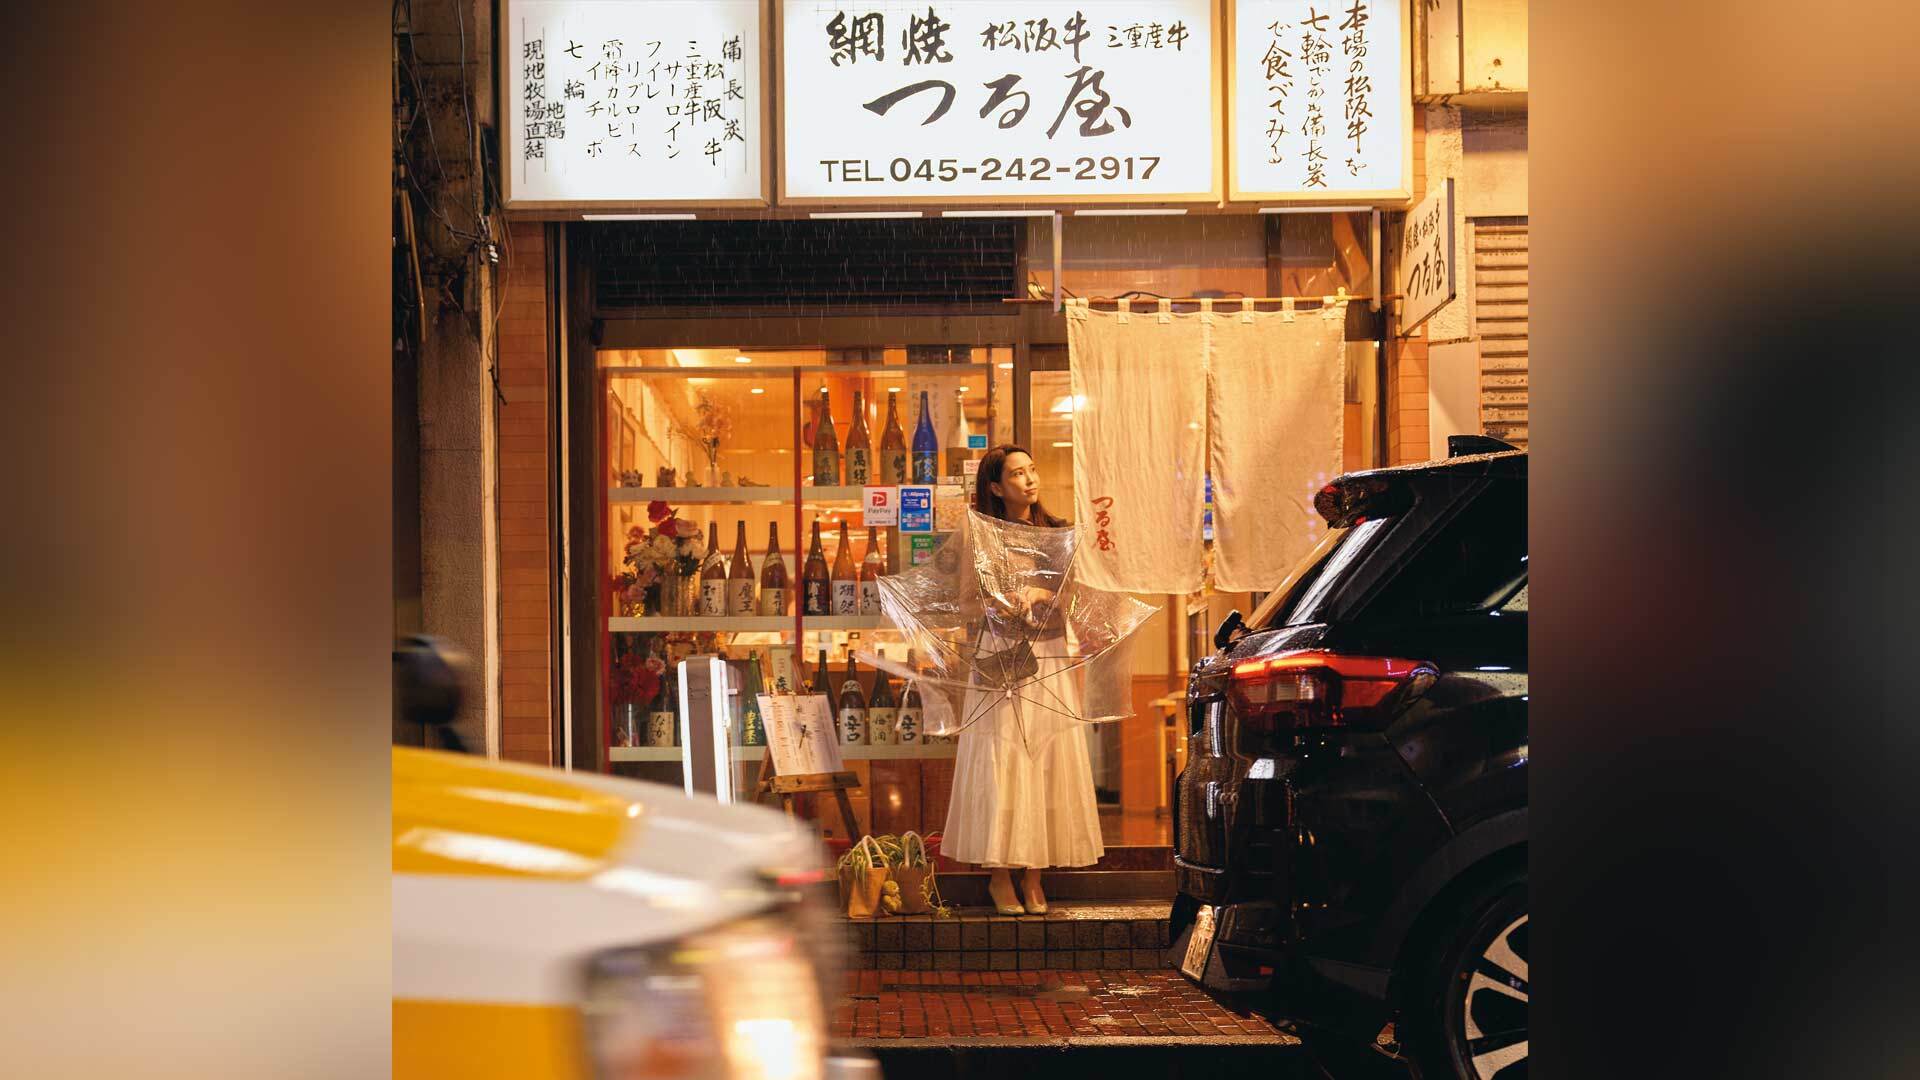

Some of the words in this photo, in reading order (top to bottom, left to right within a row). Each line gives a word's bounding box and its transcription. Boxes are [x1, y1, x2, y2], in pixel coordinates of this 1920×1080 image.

[563, 39, 585, 101] 七輪
[825, 6, 954, 67] 網焼
[980, 10, 1091, 64] 松阪牛
[1107, 20, 1189, 52] 三重産牛
[524, 39, 545, 161] 現地牧場直結
[586, 61, 605, 158] イチボ
[602, 39, 624, 138] 霜降カルビ
[627, 60, 644, 157] リブロース
[663, 60, 683, 159] サーロイン
[684, 40, 703, 126] 三重産牛
[703, 62, 726, 167] 松阪牛
[722, 35, 744, 143] 備長炭
[862, 65, 1132, 140] つる屋
[1261, 21, 1294, 164] で食べてみる
[1338, 1, 1373, 177] 本場の松阪牛を
[819, 159, 885, 183] TEL
[889, 156, 1161, 182] 045-242-2917
[1091, 496, 1115, 551] つる屋
[738, 582, 753, 612] 魔王
[844, 714, 861, 741] 辛口
[901, 714, 917, 741] 辛口
